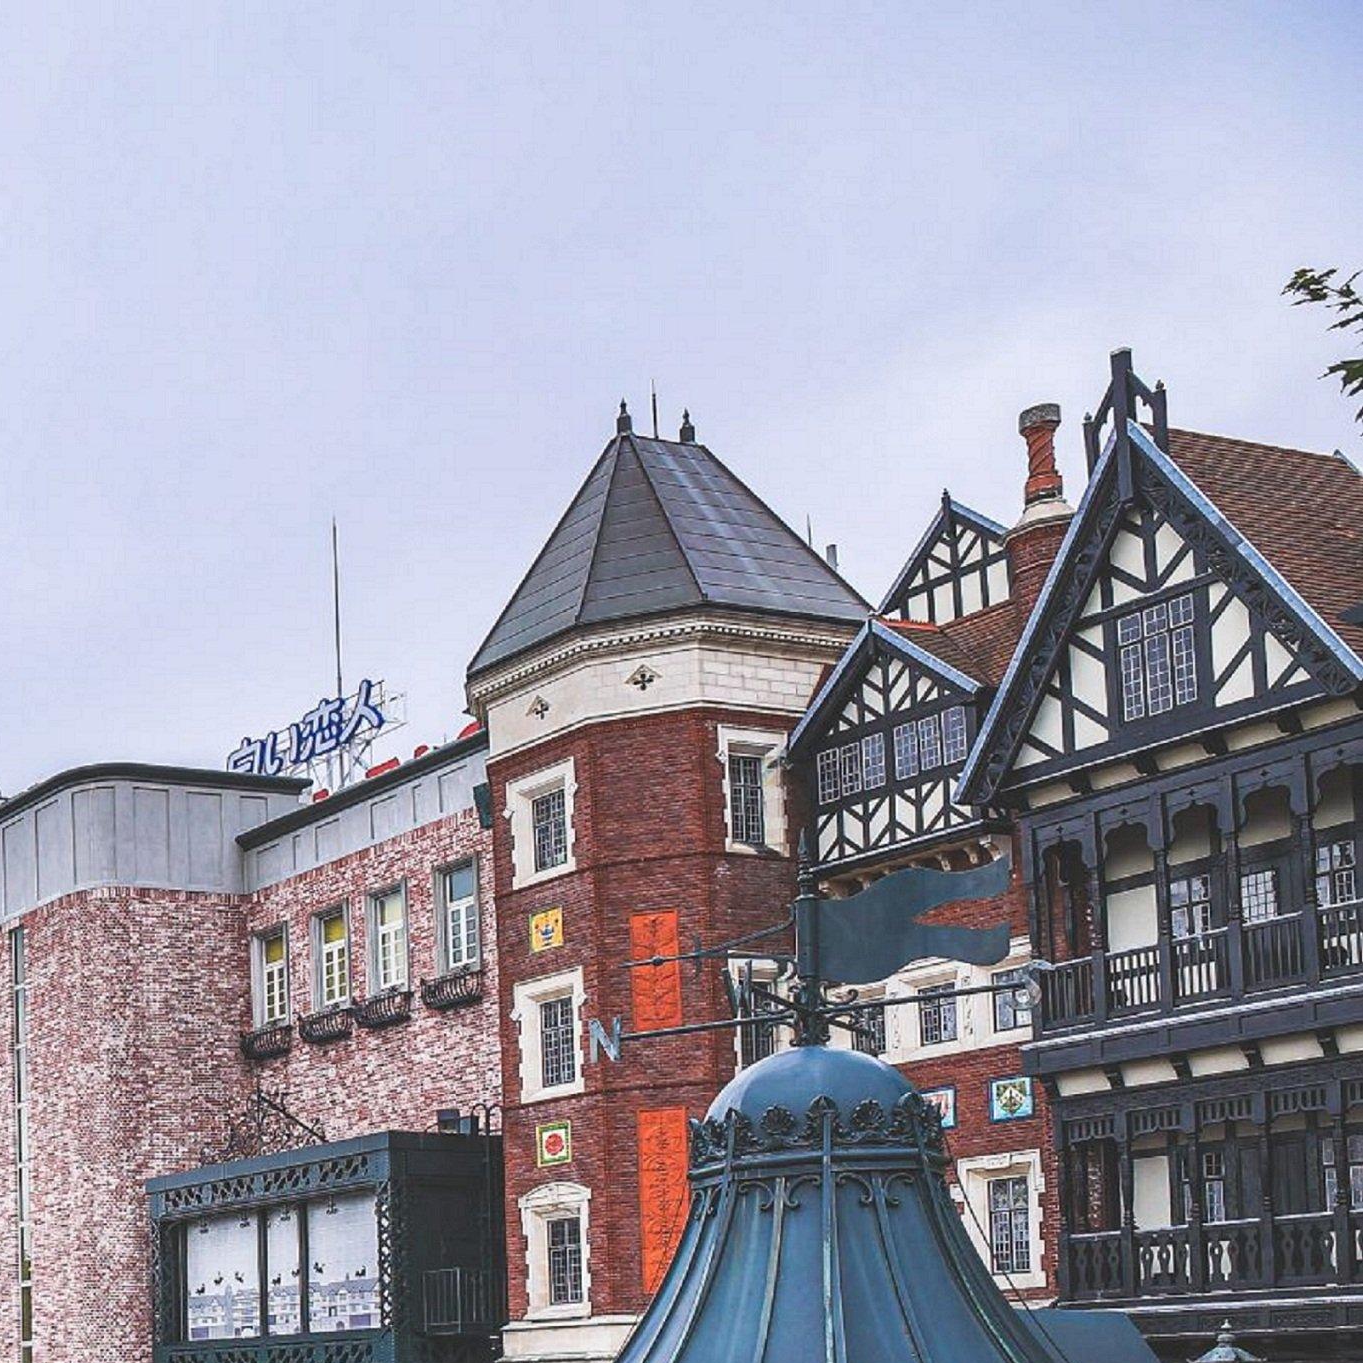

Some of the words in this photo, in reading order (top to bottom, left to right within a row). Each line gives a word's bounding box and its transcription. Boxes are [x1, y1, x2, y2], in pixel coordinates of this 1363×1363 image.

[228, 679, 385, 774] 白い恋人
[589, 1017, 622, 1063] N
